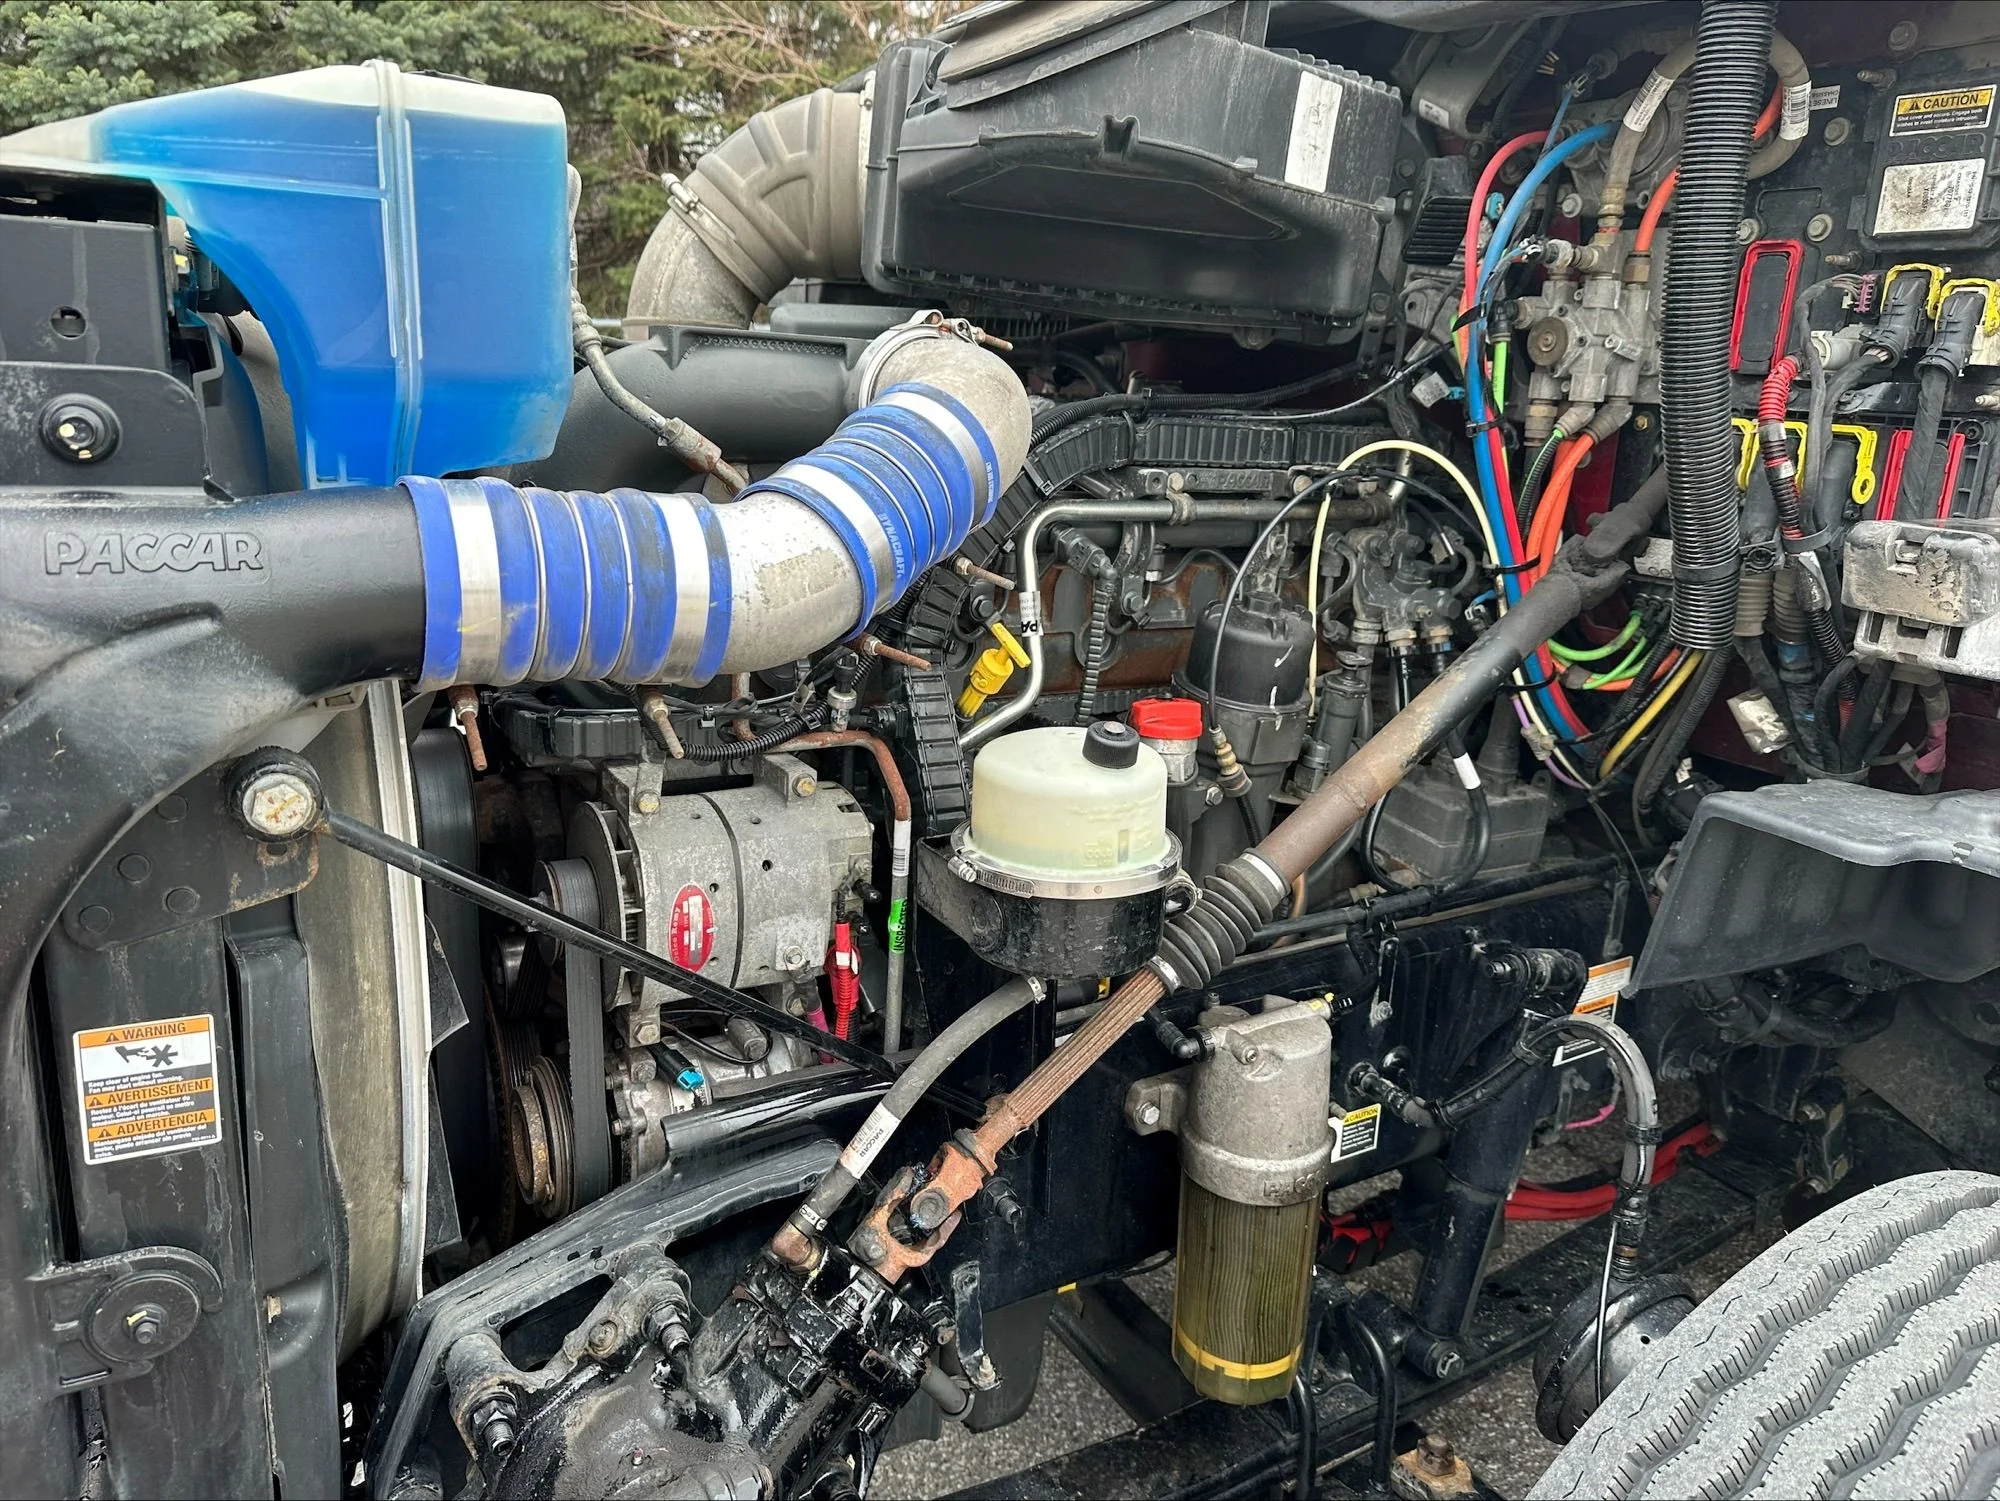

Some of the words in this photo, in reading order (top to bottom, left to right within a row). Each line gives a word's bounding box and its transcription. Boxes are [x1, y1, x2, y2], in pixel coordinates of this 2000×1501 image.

[1923, 93, 1978, 109] CAUTION
[44, 532, 264, 575] PACCAR
[879, 513, 905, 577] DYNACRAFT
[672, 907, 681, 935] Remy
[122, 1022, 185, 1040] WARNING
[106, 1078, 210, 1104] AVERTISSEMENT
[116, 1111, 206, 1135] ADVERTENCIA
[1349, 1109, 1378, 1122] CAUTION
[860, 1128, 884, 1158] PACCAR
